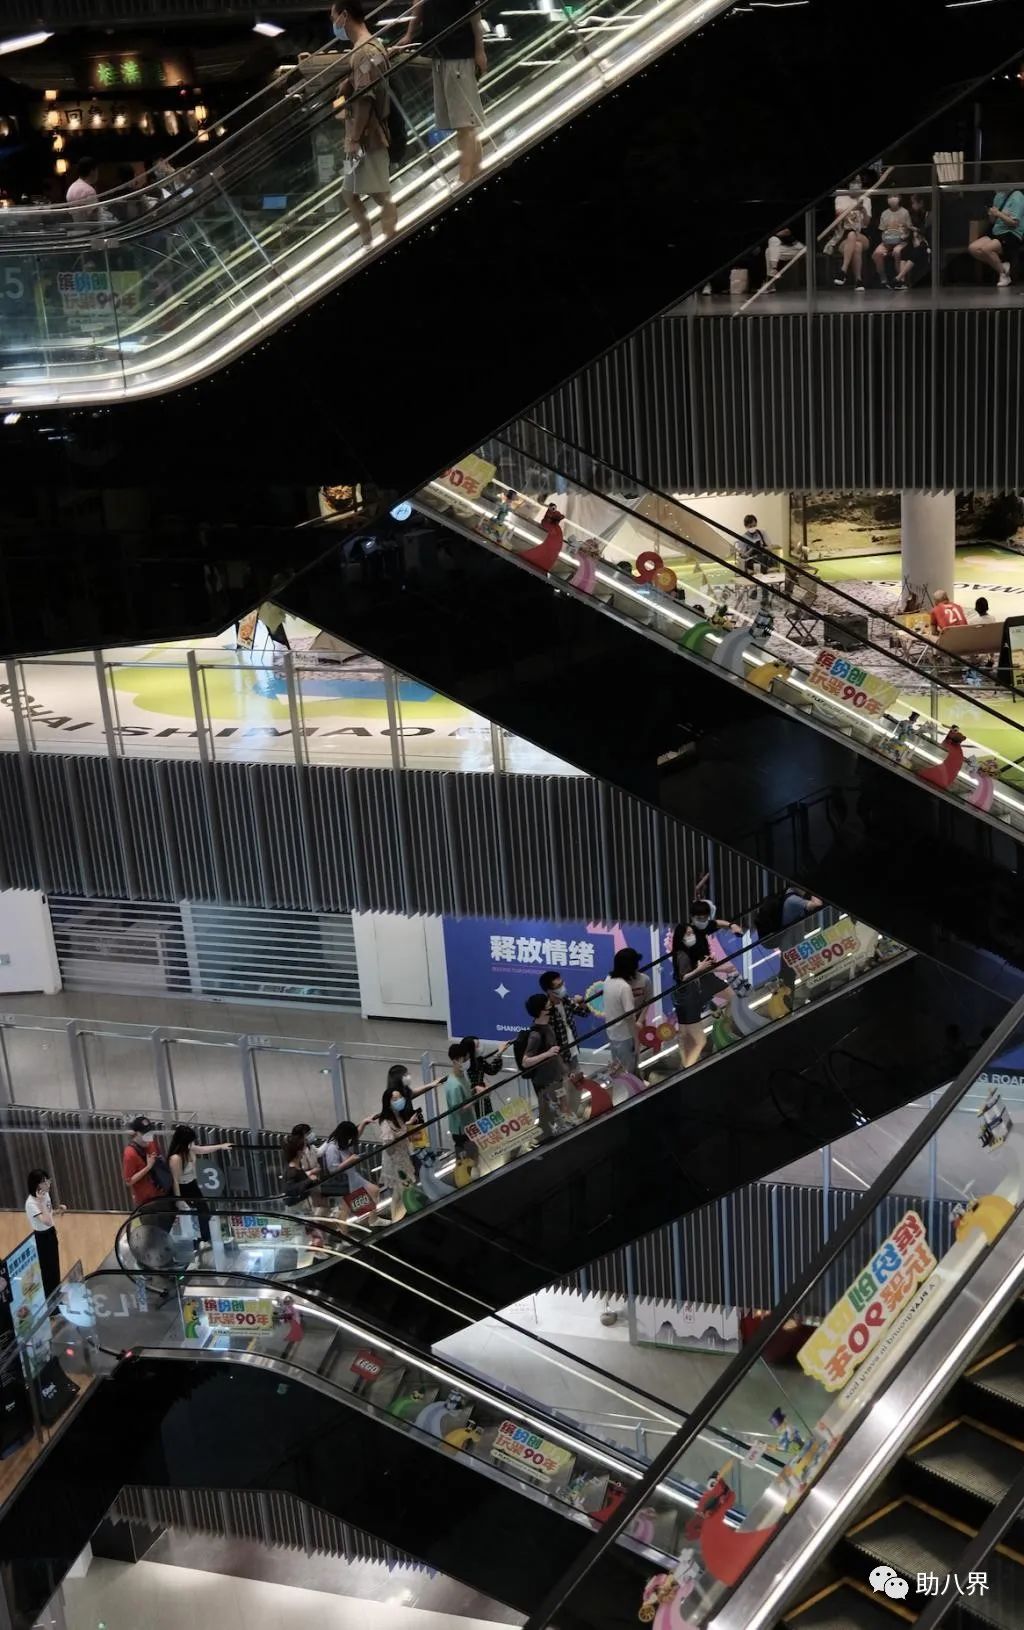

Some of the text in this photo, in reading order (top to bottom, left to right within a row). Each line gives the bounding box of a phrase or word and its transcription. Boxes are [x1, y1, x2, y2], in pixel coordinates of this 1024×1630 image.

[944, 607, 963, 624] 21
[490, 935, 595, 968] 释放情绪
[355, 1359, 380, 1375] LEGO
